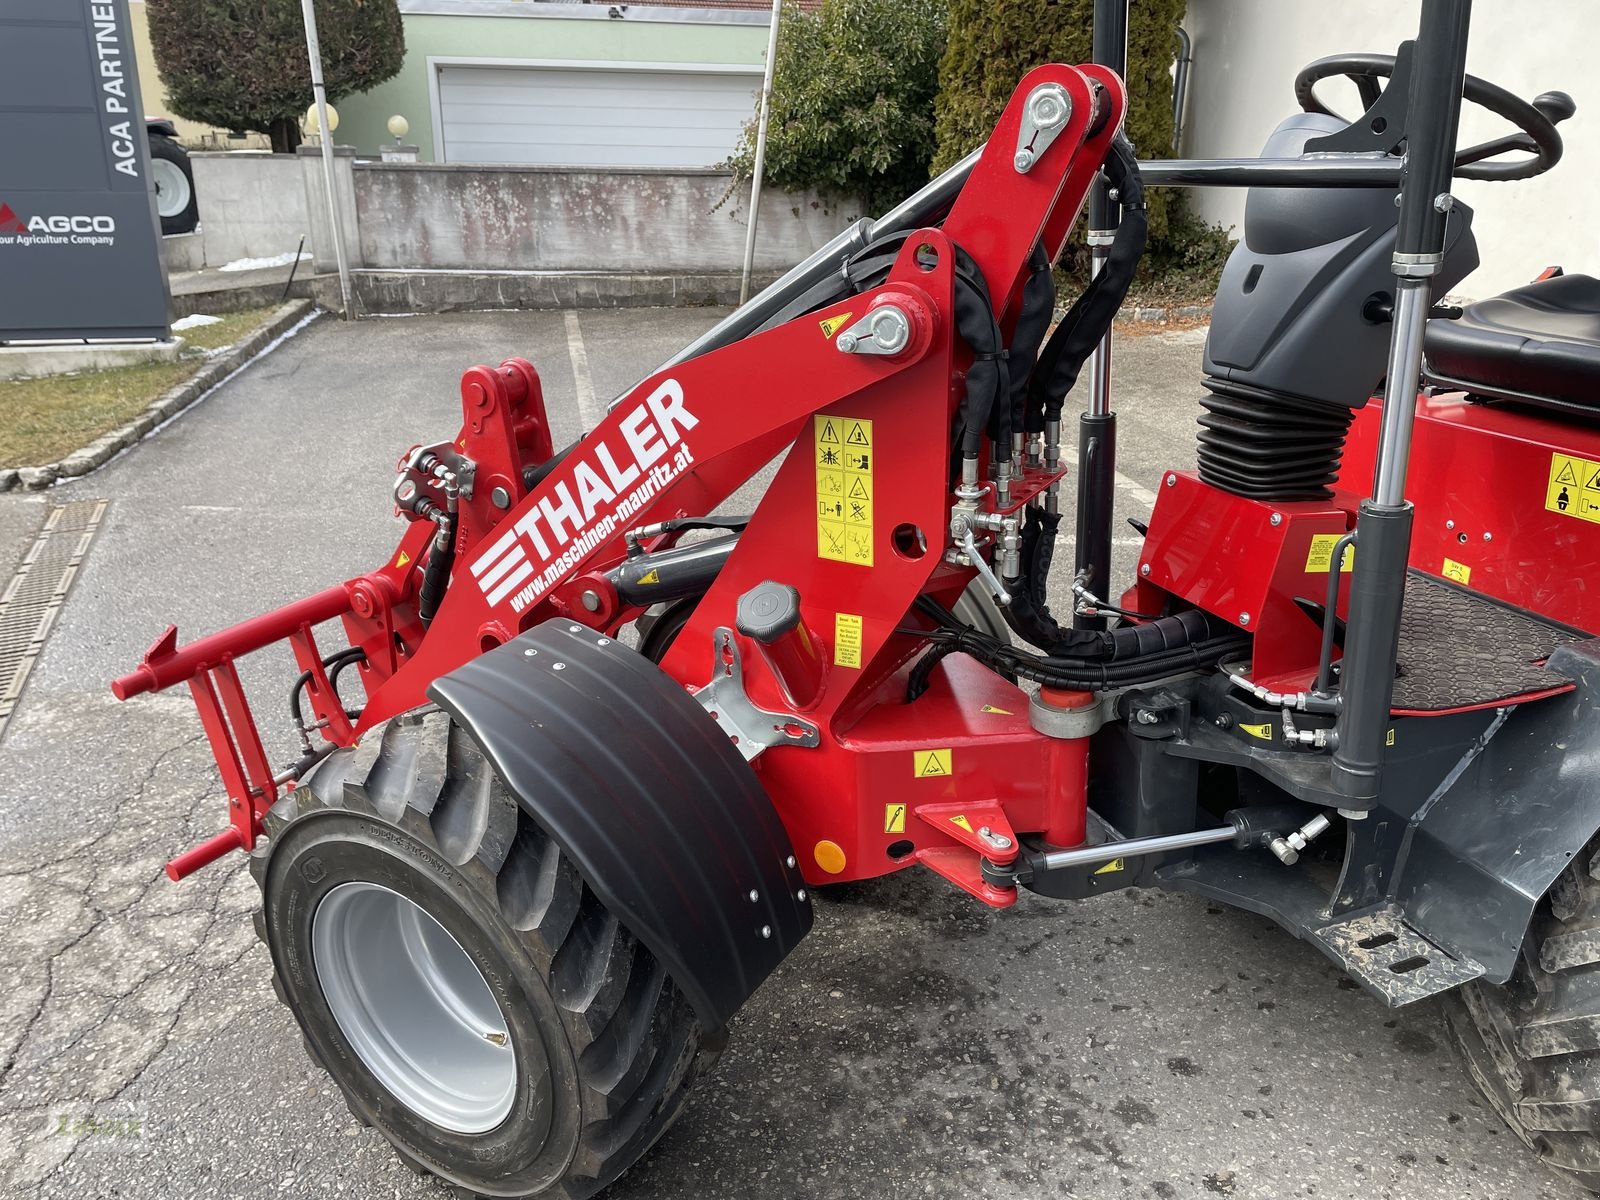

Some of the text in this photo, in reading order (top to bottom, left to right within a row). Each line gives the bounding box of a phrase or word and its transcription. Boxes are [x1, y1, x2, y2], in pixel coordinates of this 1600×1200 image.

[90, 0, 138, 177] ACA PARTNE
[0, 234, 114, 247] our Agriculture Company
[27, 215, 115, 233] AGCO
[509, 441, 695, 614] www.maschinen-mauritz.at
[513, 378, 700, 562] THALER
